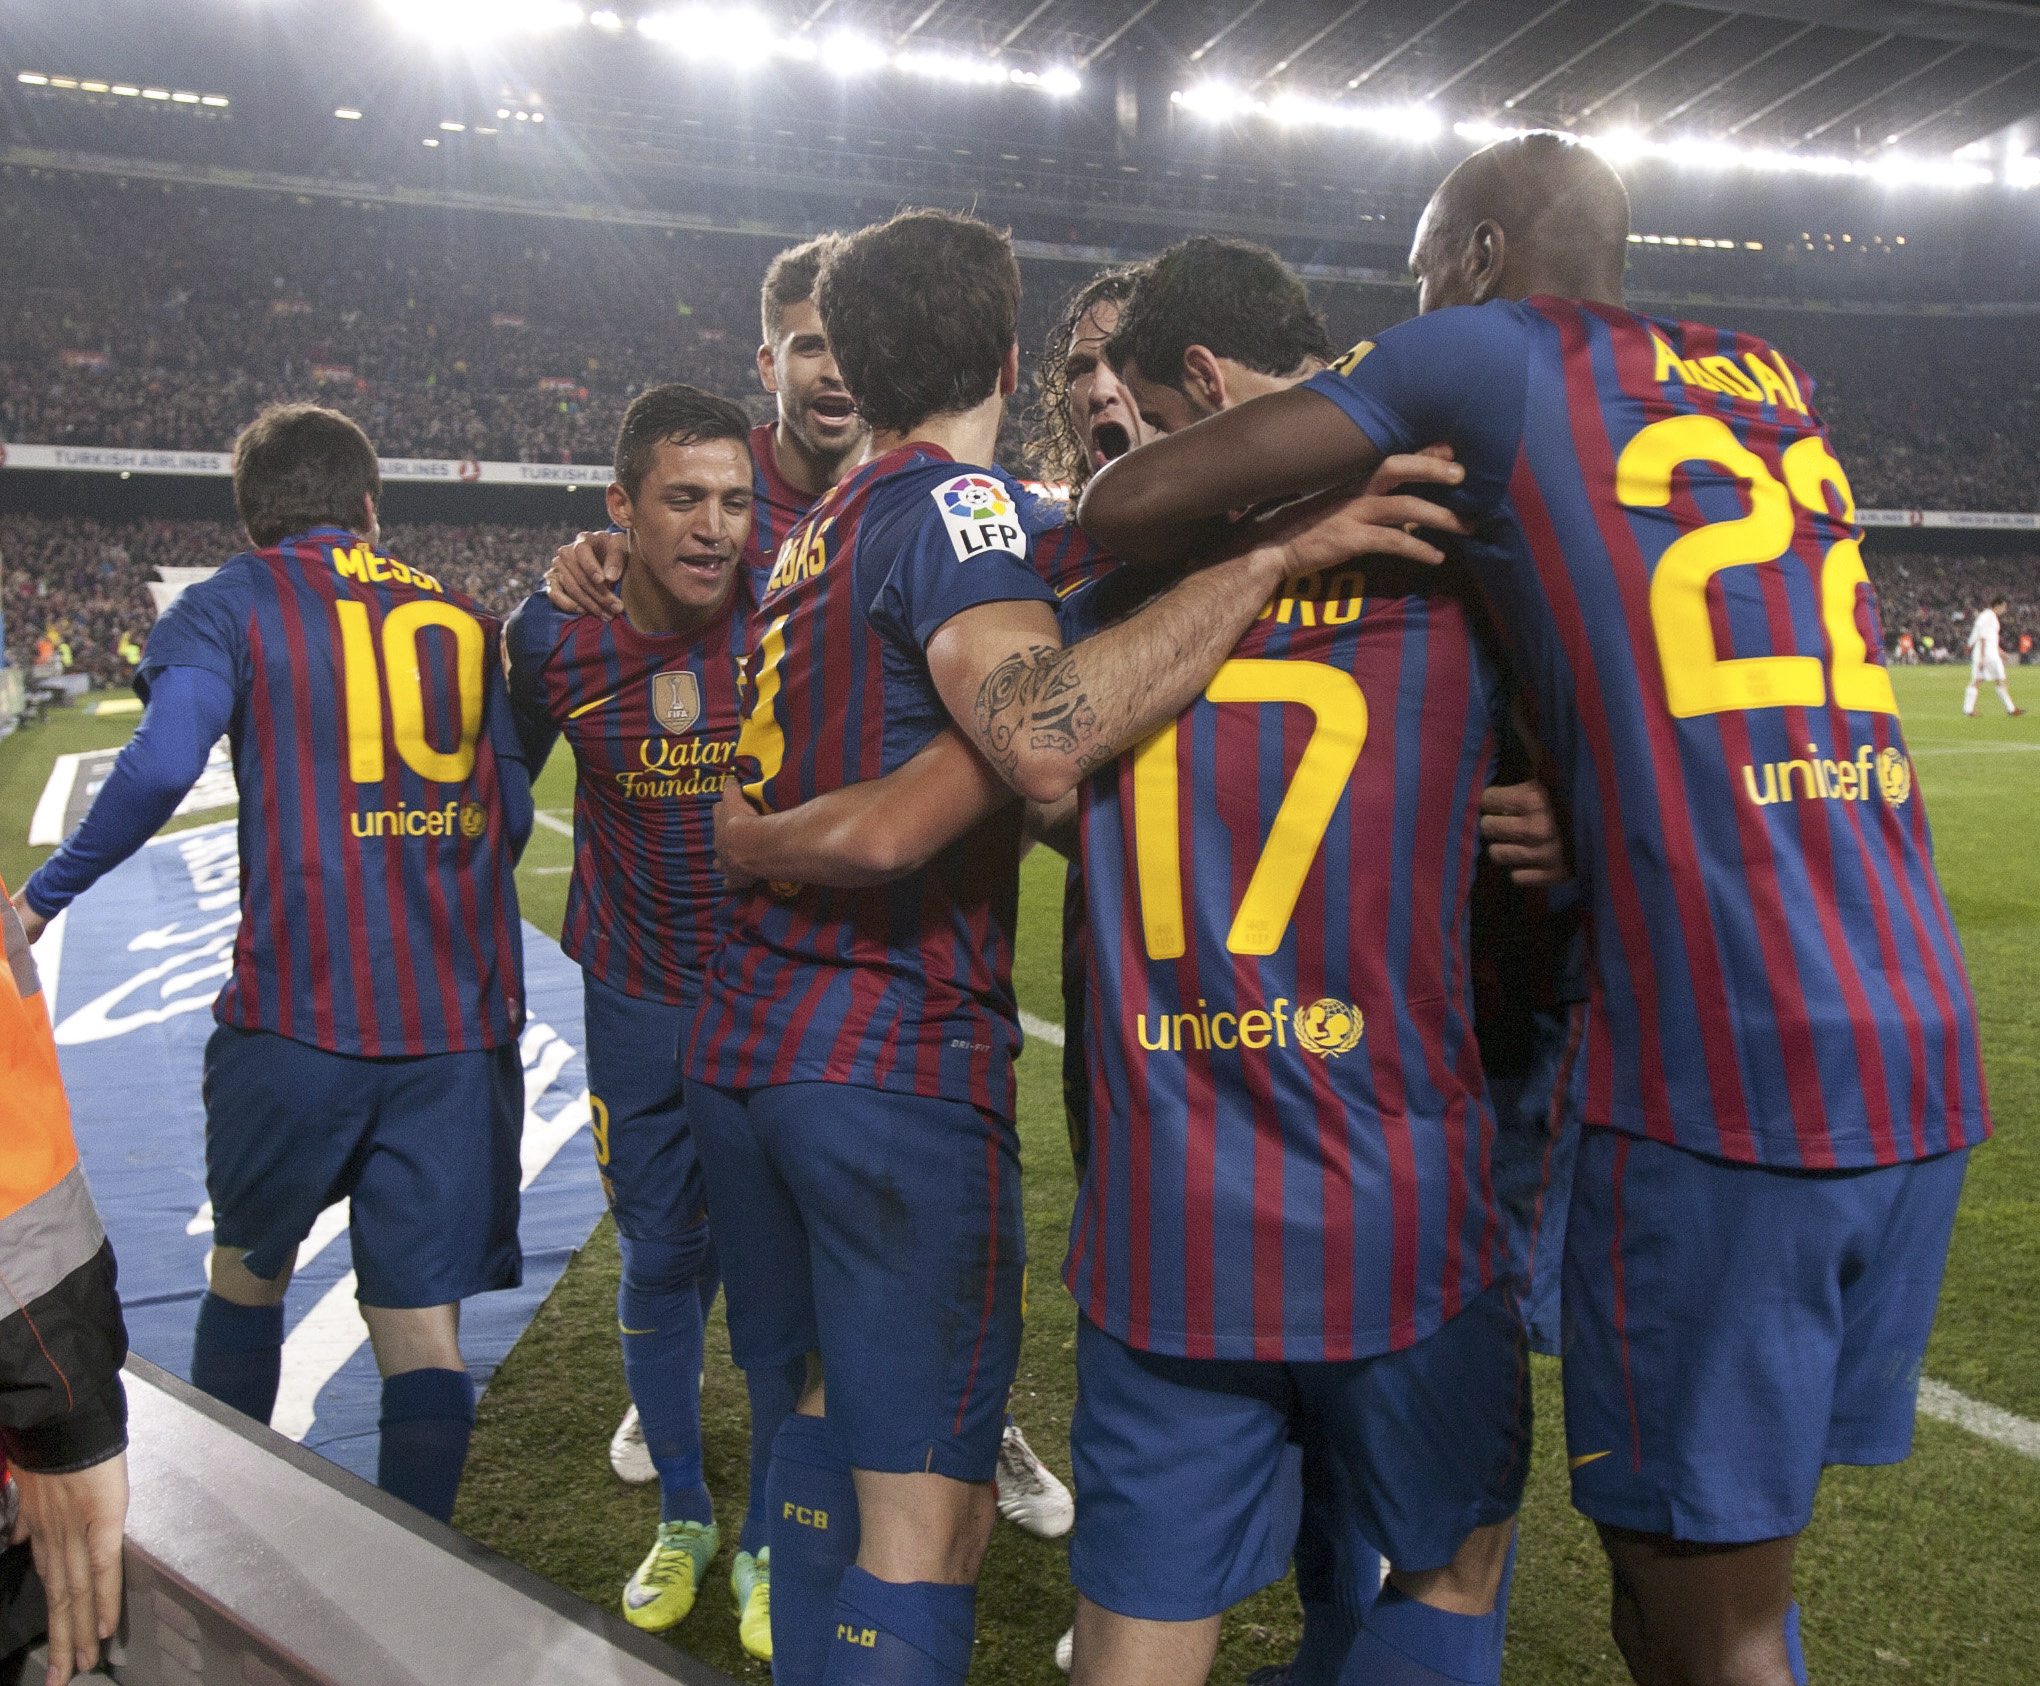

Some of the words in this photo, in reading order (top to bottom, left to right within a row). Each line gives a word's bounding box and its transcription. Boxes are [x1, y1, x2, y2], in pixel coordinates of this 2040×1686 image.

[55, 450, 136, 467] TURKISH
[138, 456, 221, 470] AIRLINES
[519, 466, 588, 480] TURKISH
[960, 523, 1018, 555] LFP
[332, 547, 444, 593] MESSI
[1616, 414, 1902, 719] 22
[1258, 570, 1366, 627] RO
[334, 599, 486, 784] 10
[667, 710, 689, 718] FIFA
[639, 736, 737, 776] Qatar
[1742, 743, 1873, 806] unicef
[350, 801, 458, 838] unicef
[1134, 658, 1369, 960] 17
[1136, 998, 1289, 1052] unicef
[950, 1039, 991, 1052] DRI-FIT
[783, 1502, 829, 1530] FCB
